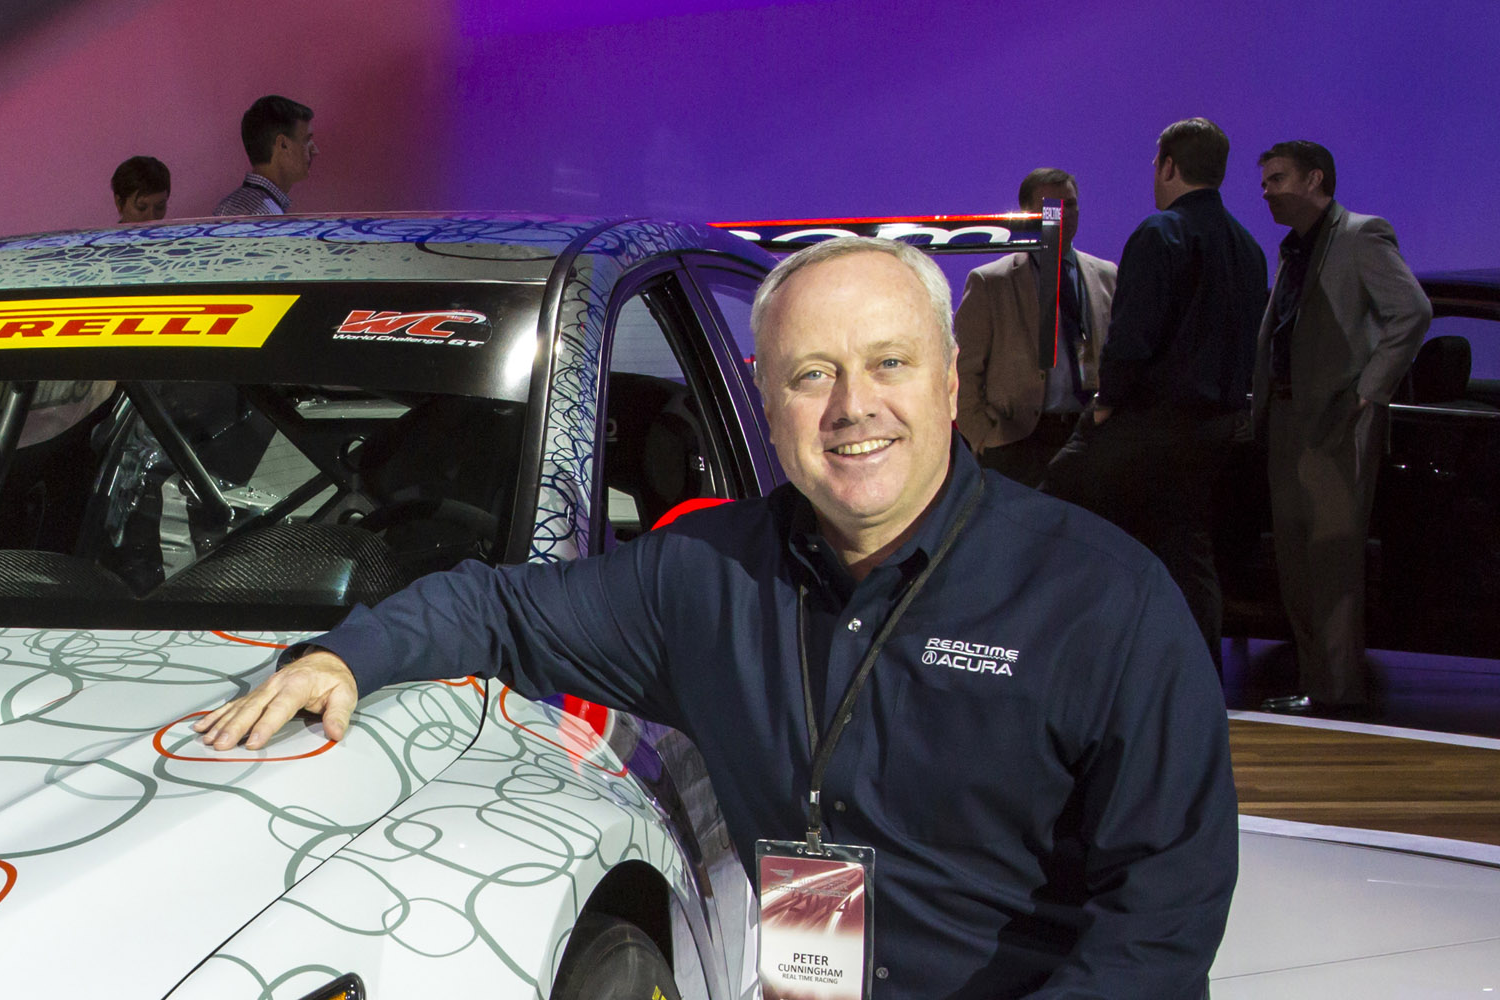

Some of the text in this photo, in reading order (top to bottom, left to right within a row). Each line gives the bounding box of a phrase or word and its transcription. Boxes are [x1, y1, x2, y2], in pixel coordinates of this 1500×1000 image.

[336, 309, 478, 338] WC
[332, 333, 485, 347] World Challenge GT
[926, 637, 1019, 659] REALTIME
[936, 654, 1013, 677] ACURA
[793, 952, 829, 966] PETER
[777, 963, 843, 978] CUNNINGHAM
[799, 974, 813, 982] TIME
[814, 976, 838, 985] RACING
